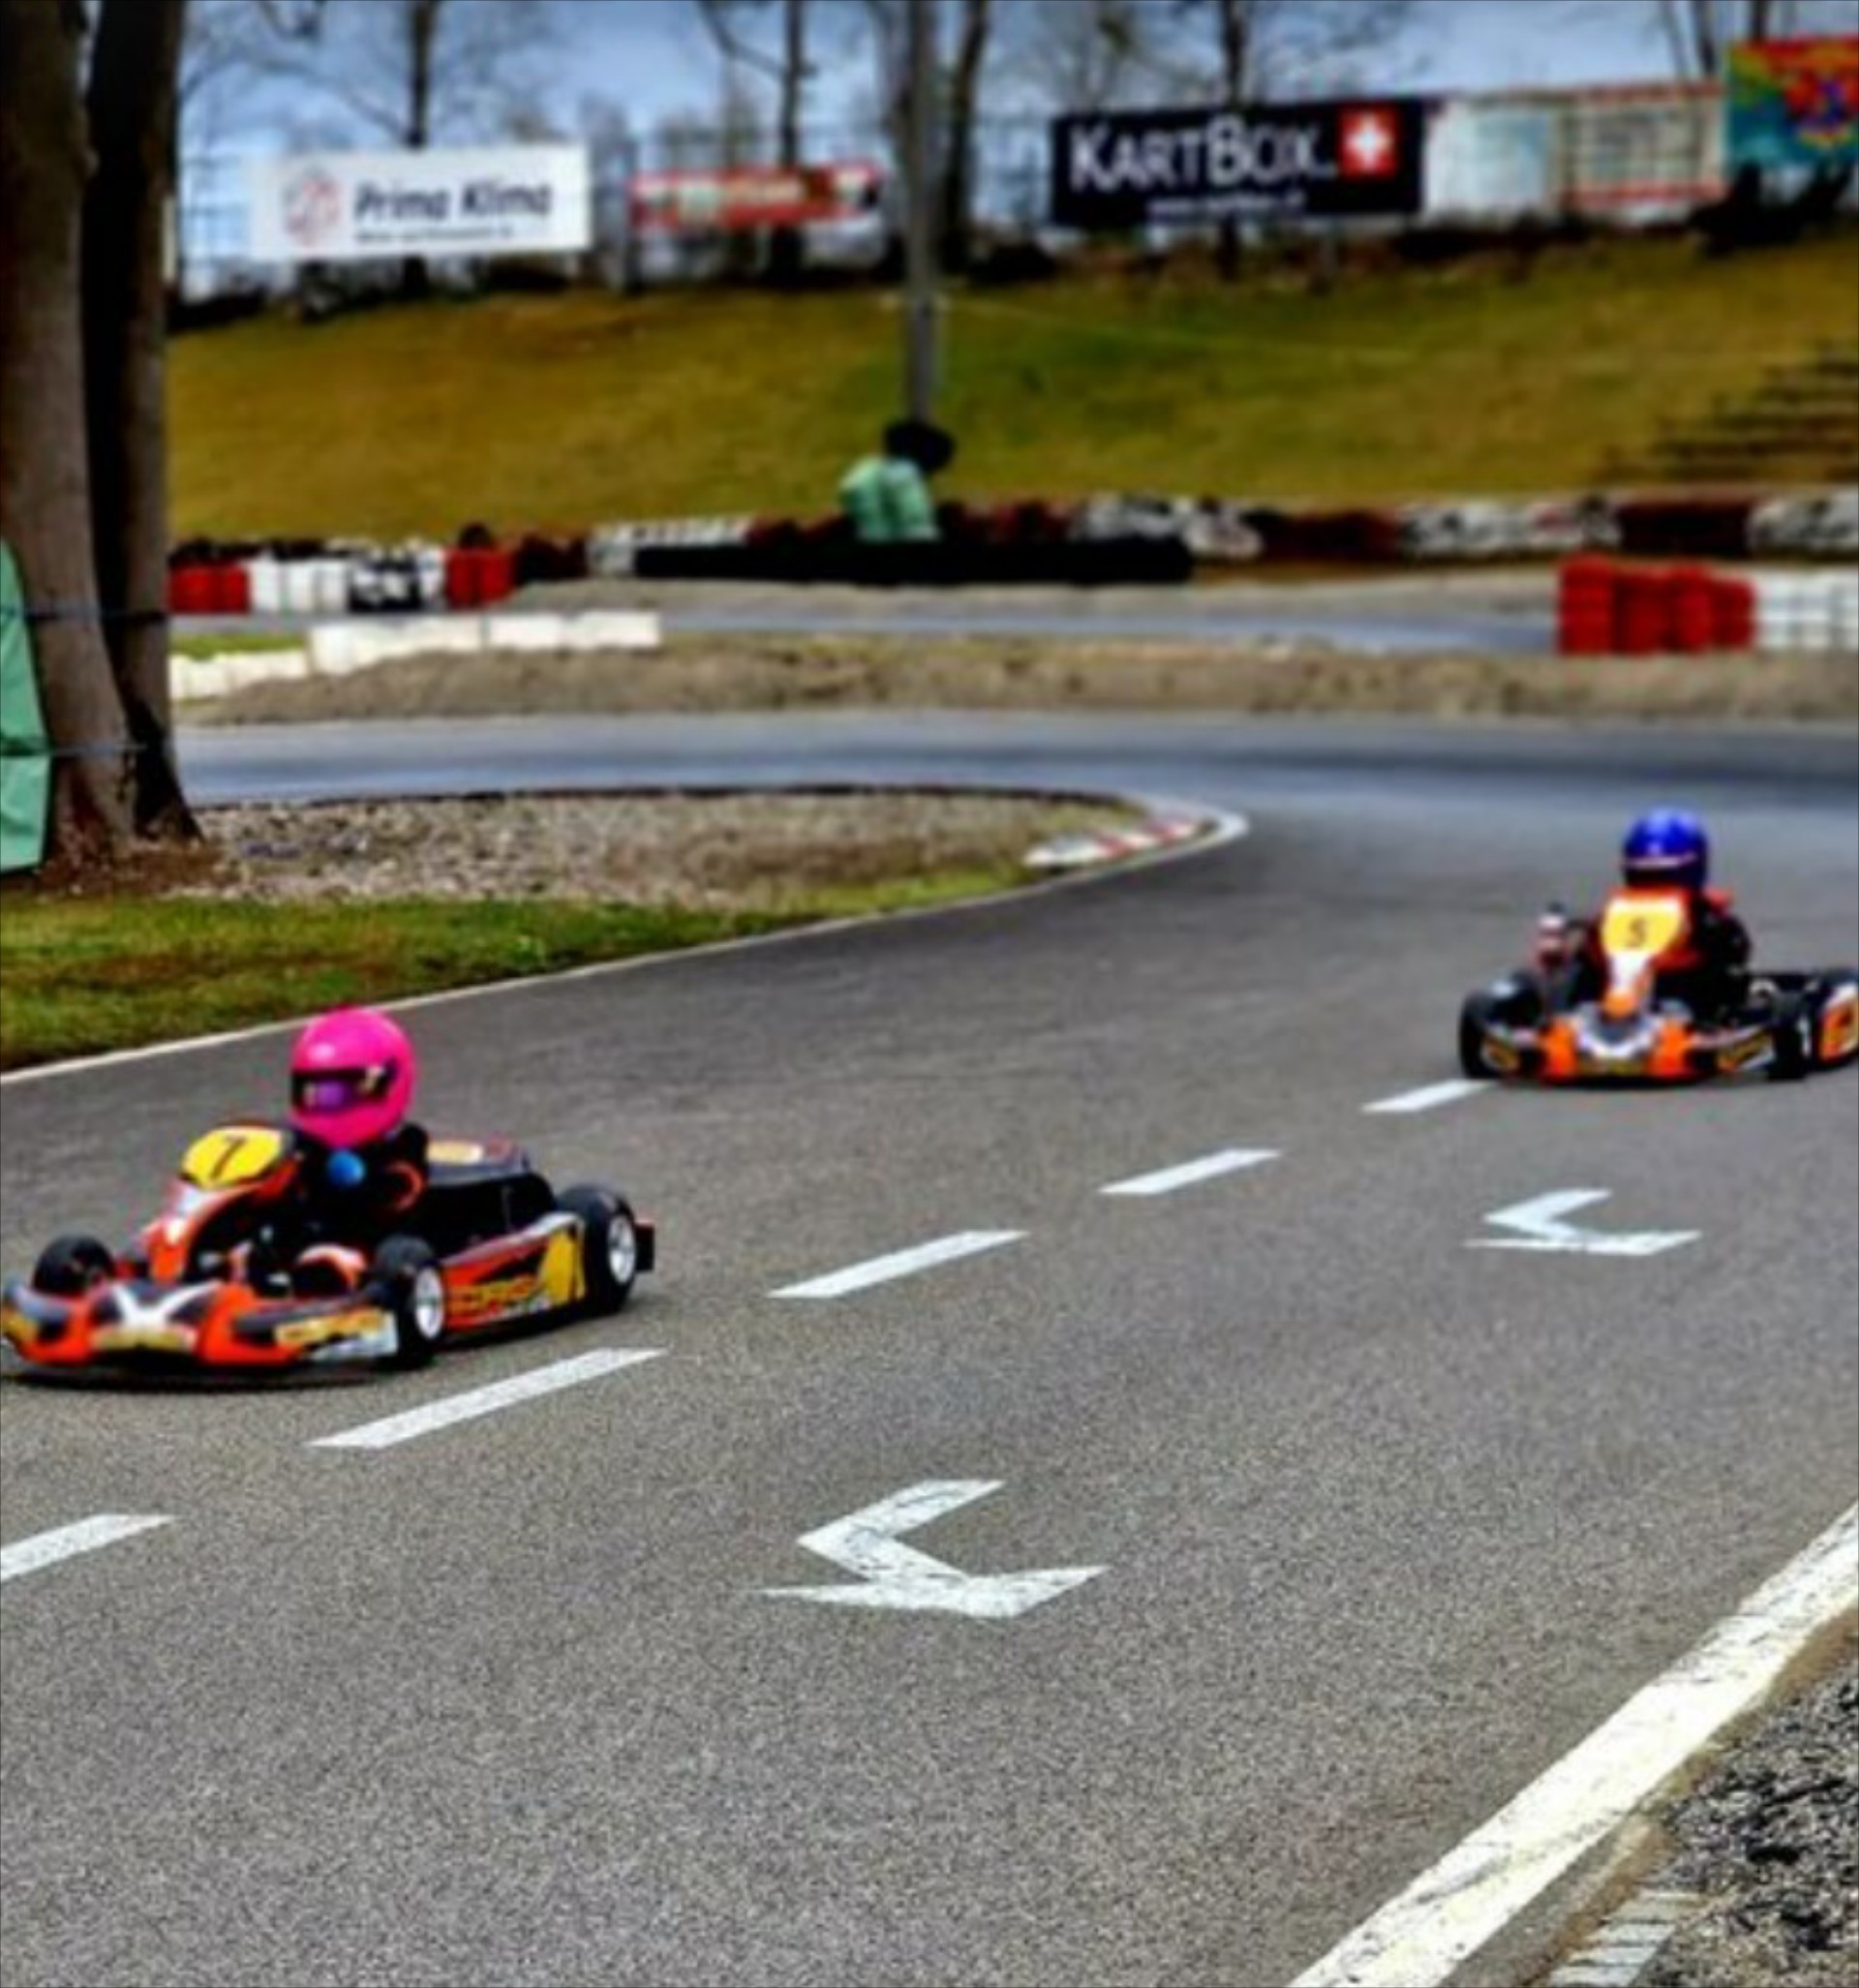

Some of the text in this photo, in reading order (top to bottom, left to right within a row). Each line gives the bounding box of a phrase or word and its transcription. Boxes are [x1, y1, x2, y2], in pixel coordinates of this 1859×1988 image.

[464, 178, 552, 216] Klima
[1626, 915, 1649, 949] 5
[210, 1133, 250, 1180] 7
